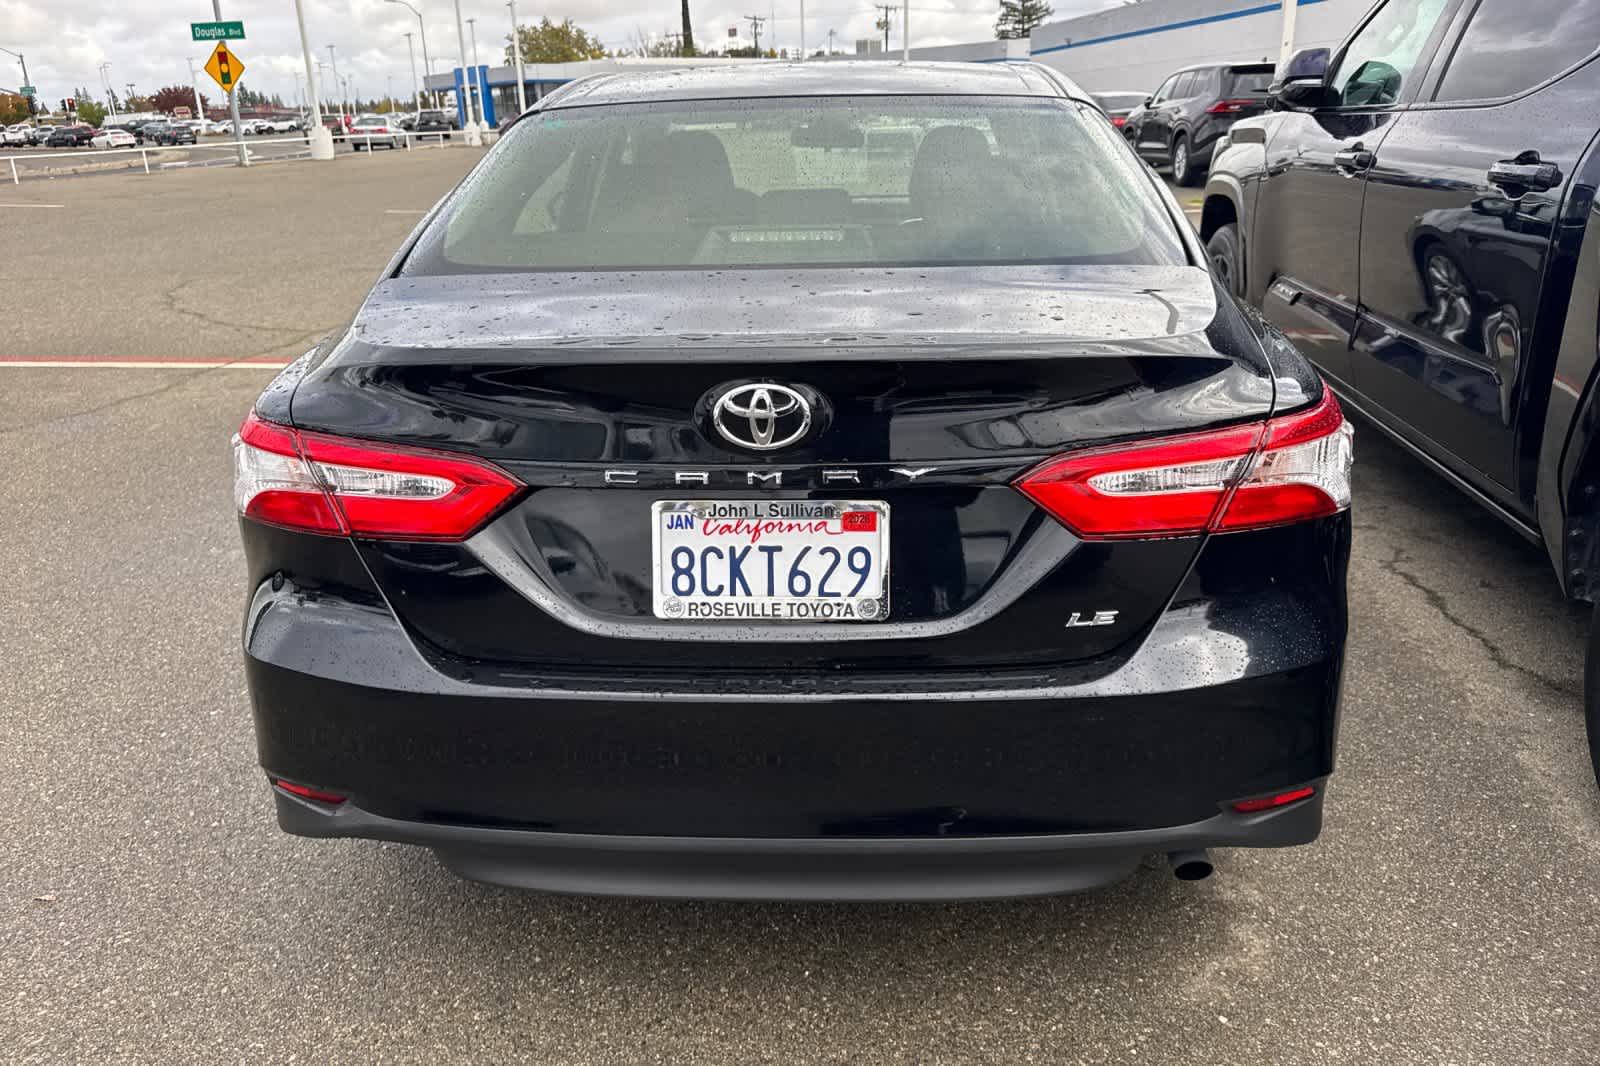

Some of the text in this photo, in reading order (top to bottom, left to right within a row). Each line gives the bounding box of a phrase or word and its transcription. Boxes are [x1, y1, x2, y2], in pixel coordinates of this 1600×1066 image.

[194, 26, 226, 39] Douglas
[604, 467, 937, 485] CAMRY
[708, 503, 835, 518] John L Sullivan
[667, 514, 694, 530] JAN
[702, 518, 843, 544] California
[671, 545, 872, 597] 8CKT629
[688, 601, 782, 618] ROSEVILLE
[786, 601, 855, 618] TOYOTA
[1065, 610, 1119, 627] LE
